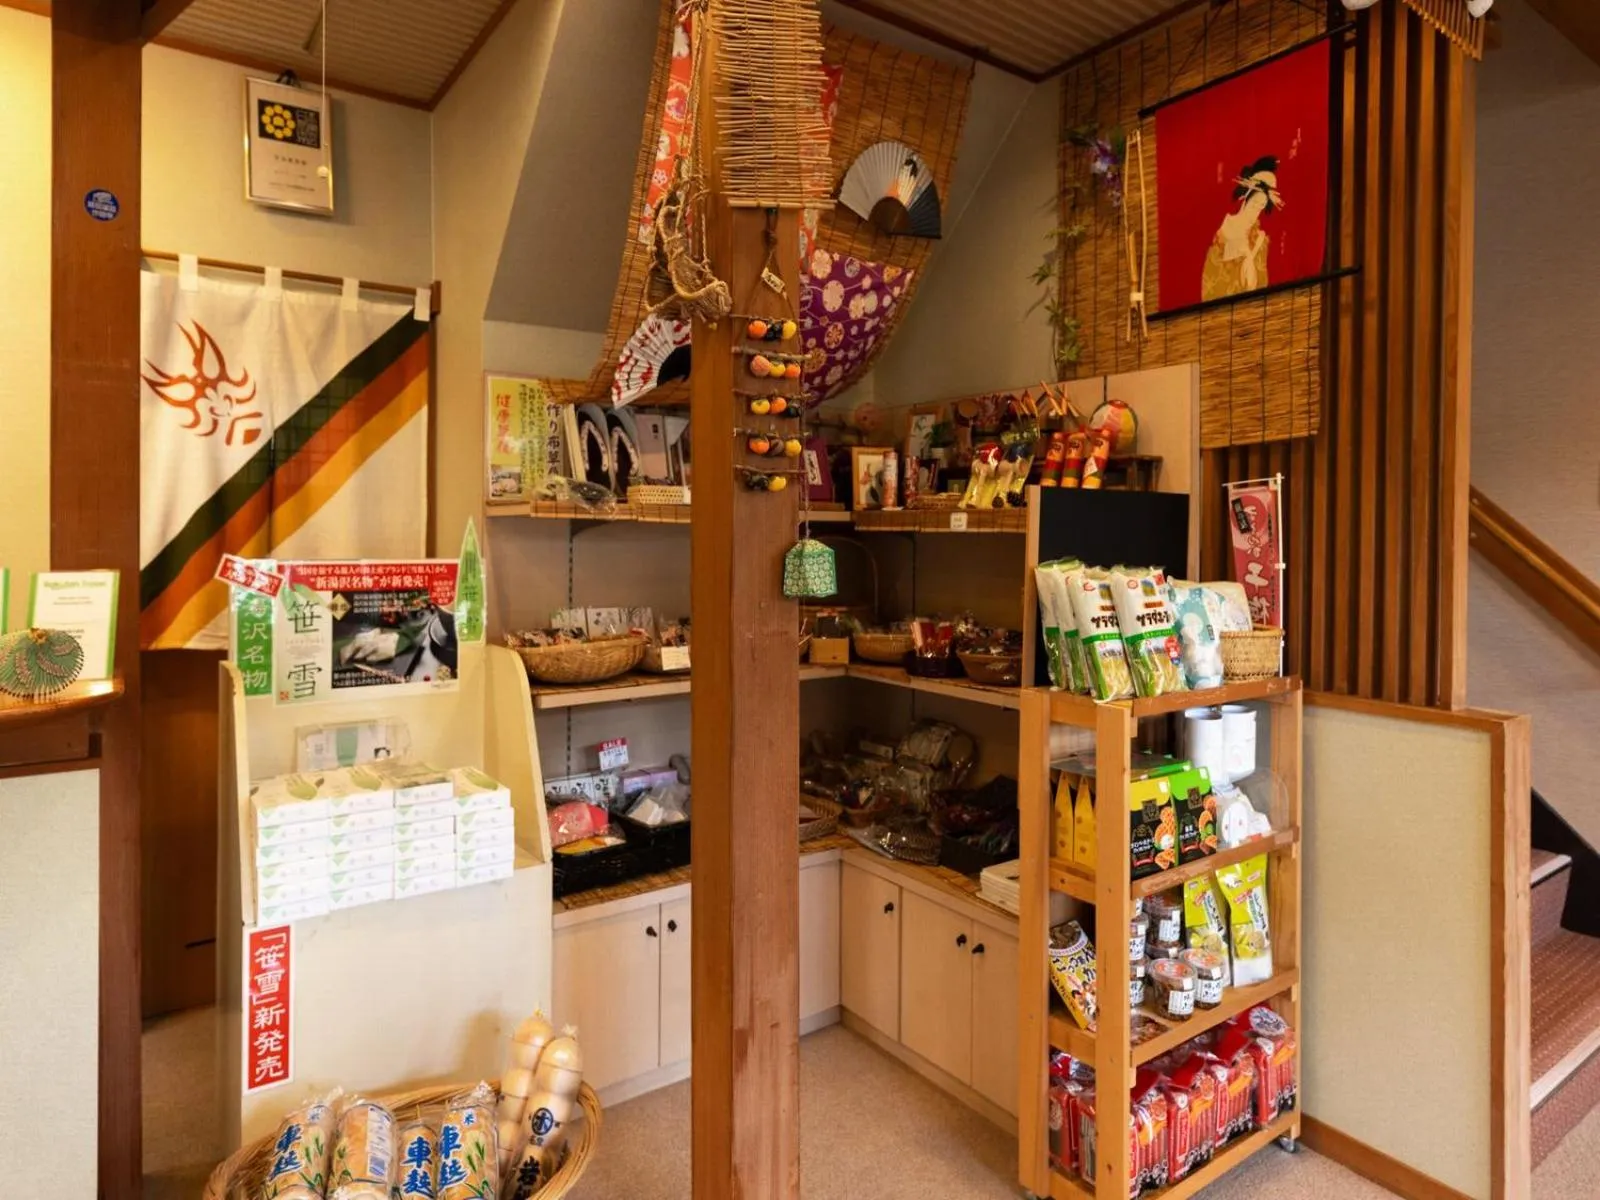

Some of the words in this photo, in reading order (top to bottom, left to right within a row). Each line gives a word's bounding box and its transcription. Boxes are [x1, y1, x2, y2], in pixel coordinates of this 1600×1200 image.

[287, 600, 322, 699] 笹雪
[252, 932, 287, 1083] 「笹雪」新発売
